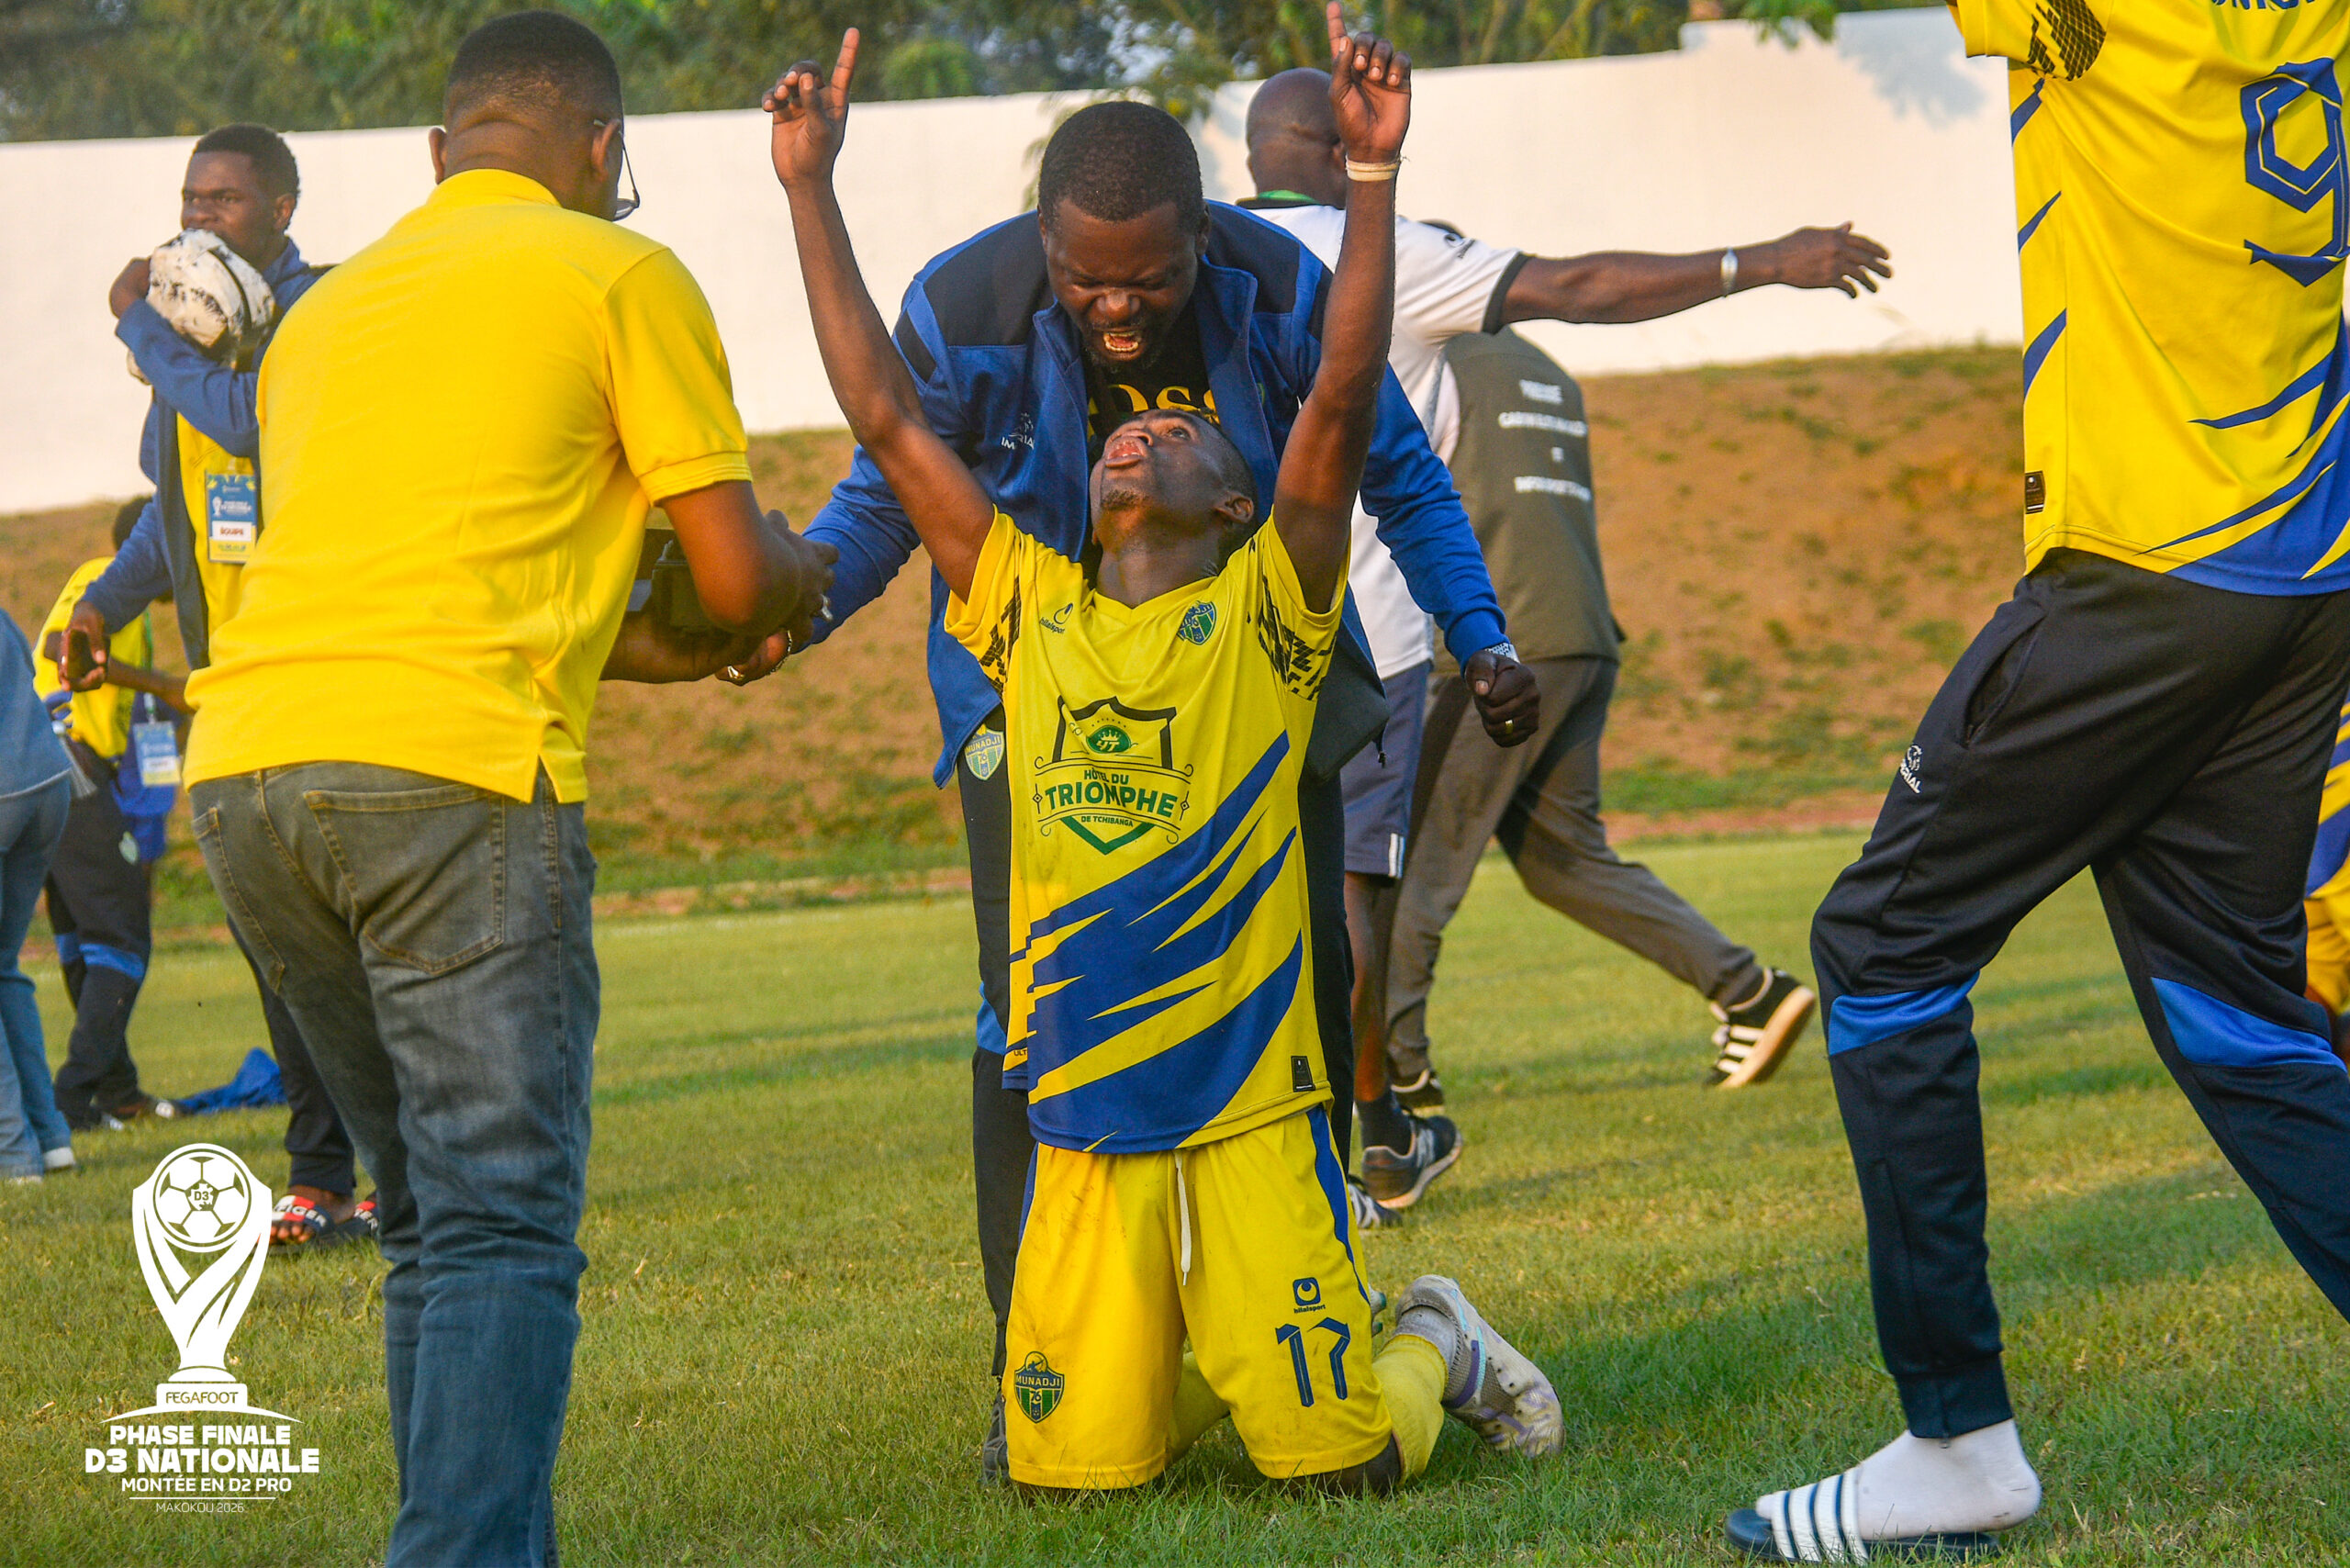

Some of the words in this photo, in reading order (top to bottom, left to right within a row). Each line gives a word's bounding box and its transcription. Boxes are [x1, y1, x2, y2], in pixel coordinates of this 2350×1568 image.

[2240, 57, 2350, 287] 9
[1083, 767, 1110, 783] HÔTEL
[1112, 774, 1129, 785] DU
[1045, 781, 1179, 818] TRIOMPHE
[1092, 816, 1135, 828] TCHIBANGA
[1293, 1305, 1326, 1314] hilalsport
[1274, 1316, 1351, 1408] 17
[1015, 1374, 1060, 1387] MUNADJI
[1029, 1389, 1042, 1402] 76
